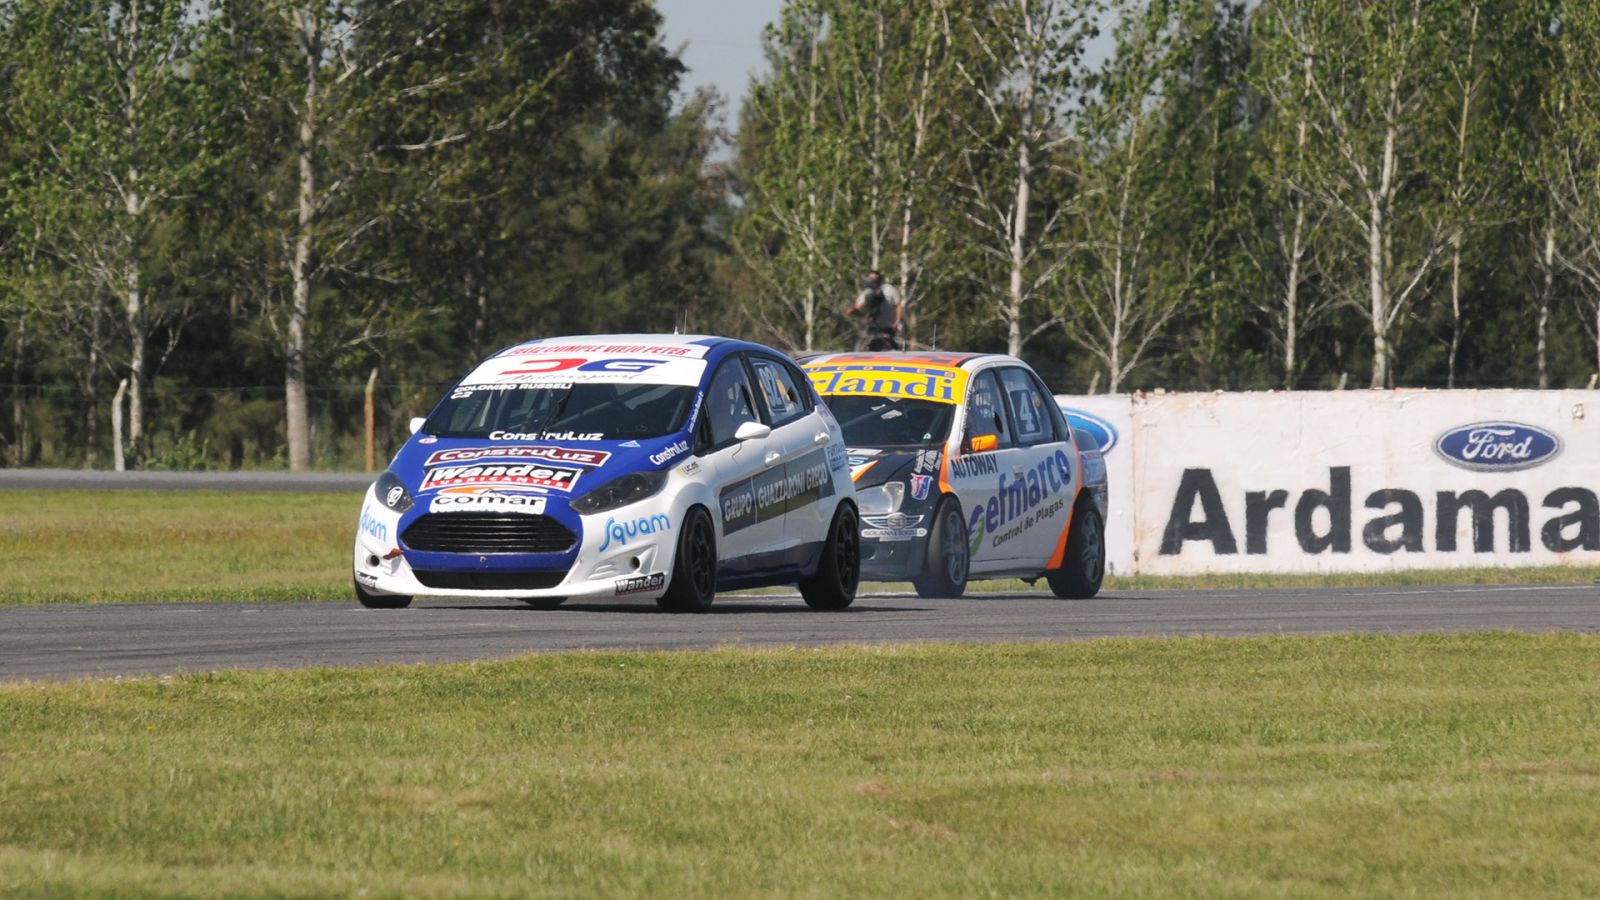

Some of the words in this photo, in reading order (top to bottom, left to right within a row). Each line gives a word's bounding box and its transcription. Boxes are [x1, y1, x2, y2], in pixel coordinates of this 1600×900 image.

[543, 345, 606, 353] CUMPLE
[603, 345, 644, 353] VIEJO
[643, 346, 692, 356] PETER
[808, 365, 956, 379] UEBLES
[453, 384, 517, 394] COLOMBO
[1020, 391, 1036, 432] 4
[648, 440, 690, 466] ConstruLuz
[1461, 428, 1533, 460] Ford
[439, 447, 597, 463] ConstruLuz
[430, 464, 573, 482] Wander
[950, 453, 998, 479] AUTOWAY
[427, 476, 564, 488] LUBRICANTES
[724, 492, 752, 522] GRUPO
[758, 470, 806, 510] GUAZZARONI
[806, 462, 829, 490] GRECO
[434, 496, 544, 507] comar
[992, 522, 1023, 548] Control
[1024, 516, 1035, 531] de
[1036, 498, 1064, 524] Plagas
[598, 513, 671, 553] Squam
[615, 575, 665, 592] Wander
